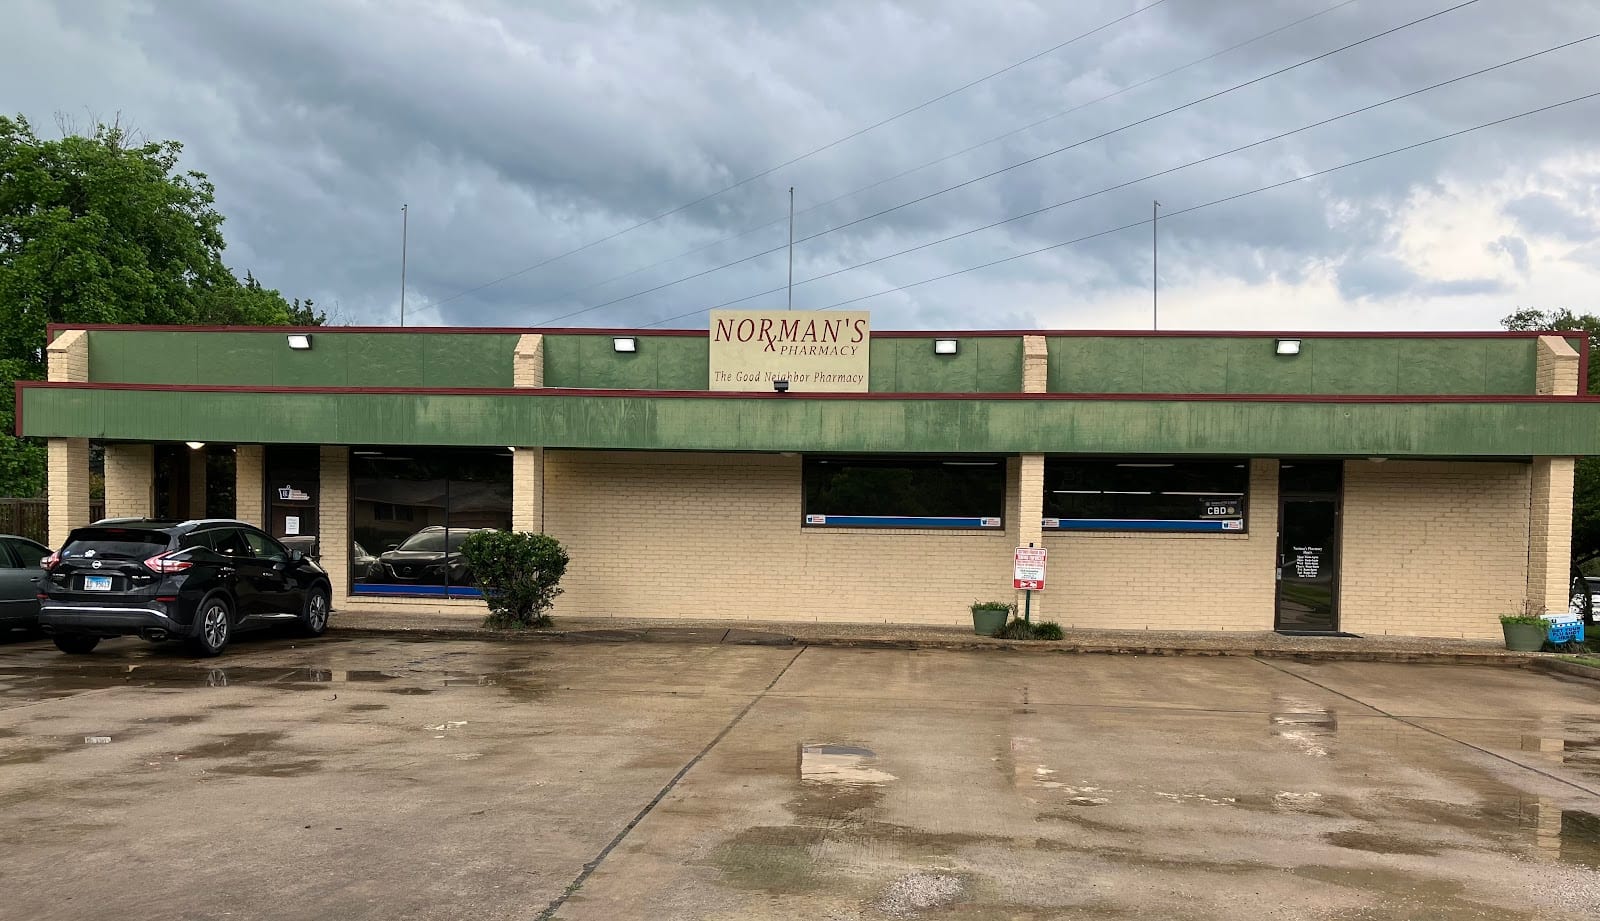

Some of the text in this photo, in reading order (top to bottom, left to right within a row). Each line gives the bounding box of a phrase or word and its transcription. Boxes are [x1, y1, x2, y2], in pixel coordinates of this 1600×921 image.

[715, 318, 866, 352] NORMAN'S
[780, 345, 859, 356] PHARMACY
[714, 371, 732, 382] The
[736, 371, 760, 382] Good
[814, 371, 864, 385] Pharmacy
[1207, 506, 1227, 515] CBD
